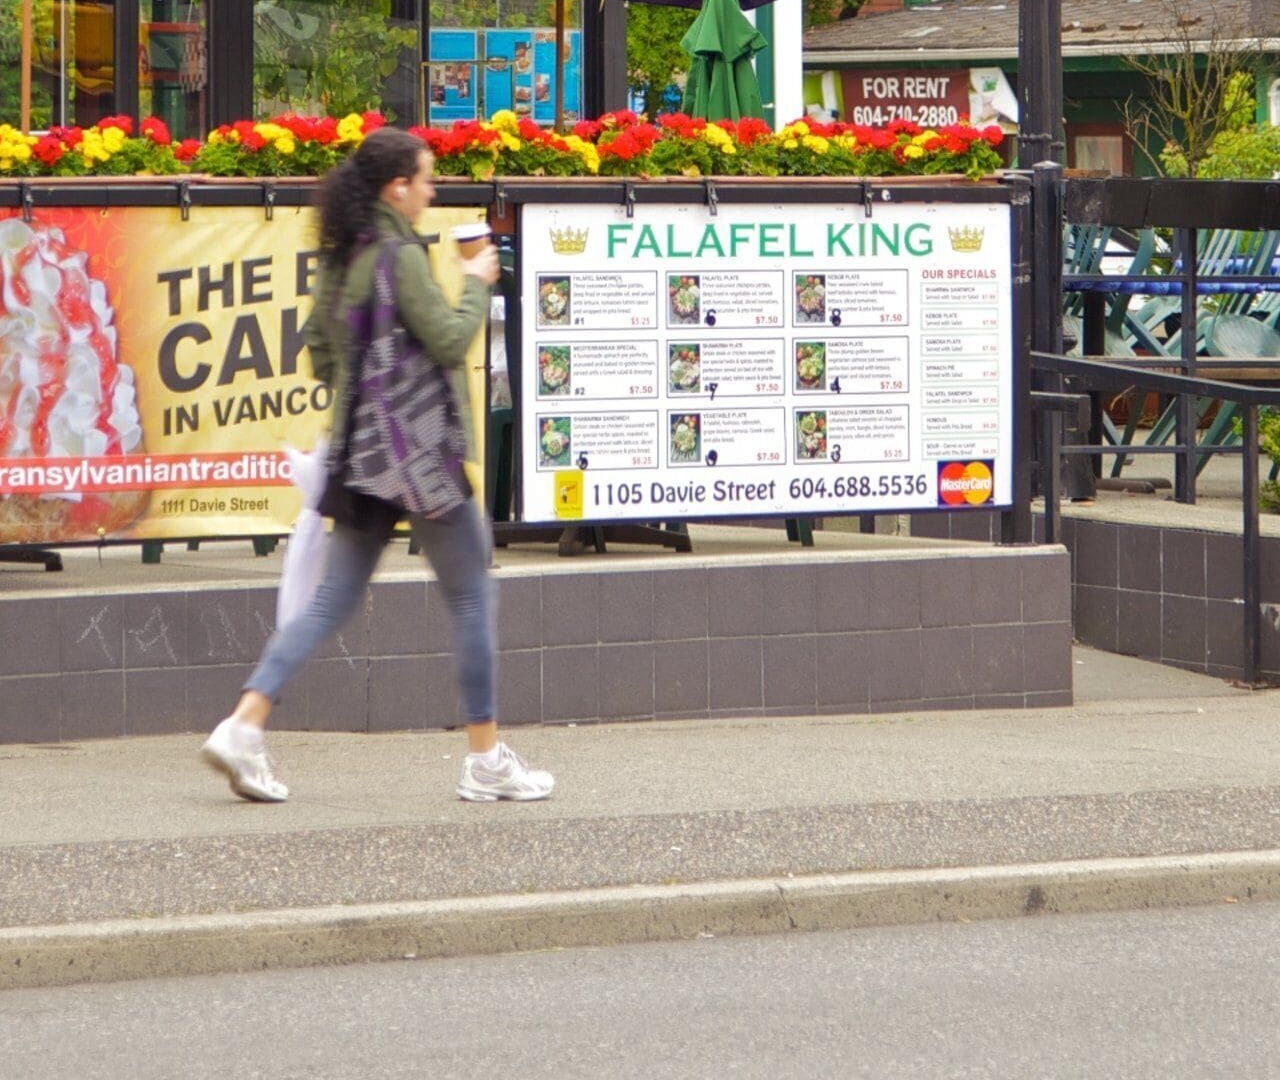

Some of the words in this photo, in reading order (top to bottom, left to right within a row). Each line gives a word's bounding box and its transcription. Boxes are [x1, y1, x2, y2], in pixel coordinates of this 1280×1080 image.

[862, 77, 899, 99] FOR
[904, 77, 950, 98] RENT
[853, 105, 957, 127] 604-710-2880
[607, 223, 814, 258] FALAFEL
[827, 223, 934, 257] KING
[922, 269, 944, 279] OUR
[947, 269, 997, 279] SPECIALS
[157, 255, 273, 316] THE
[755, 316, 778, 324] $7.50
[880, 314, 902, 322] $7.50
[158, 307, 312, 393] CAK
[629, 386, 653, 394] $7.50
[755, 383, 779, 391] $7.50
[880, 381, 902, 390] $7.50
[163, 400, 199, 436] IN
[213, 384, 334, 427] VANCO
[756, 452, 780, 460] $7.50
[593, 483, 642, 505] 1105
[650, 481, 706, 503] Davie
[713, 479, 776, 501] Street
[789, 475, 927, 498] 604.688.5536
[941, 477, 992, 491] MasterCard
[161, 499, 185, 513] 1111
[190, 498, 226, 512] Davie
[230, 497, 269, 511] Street
